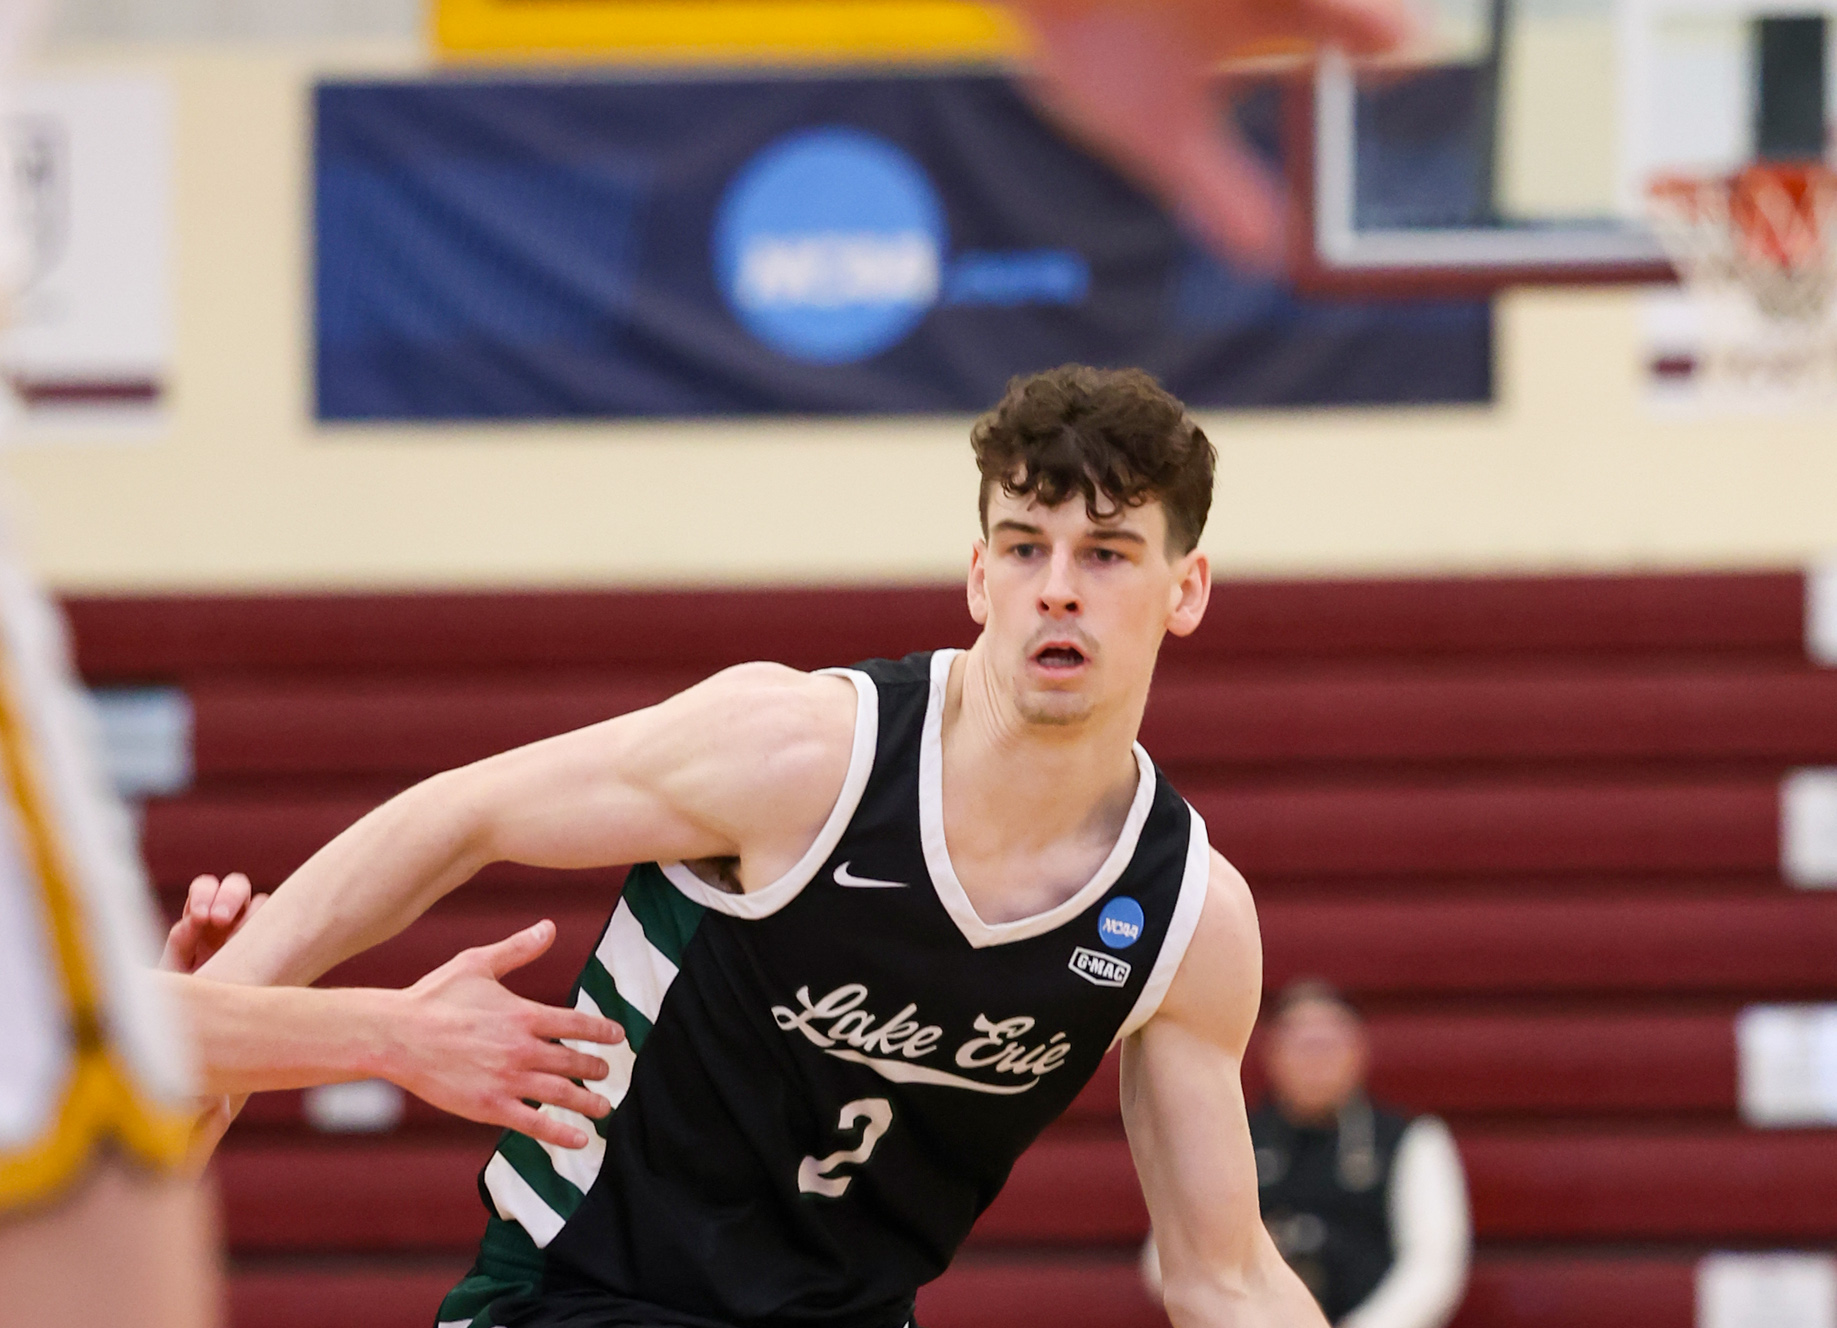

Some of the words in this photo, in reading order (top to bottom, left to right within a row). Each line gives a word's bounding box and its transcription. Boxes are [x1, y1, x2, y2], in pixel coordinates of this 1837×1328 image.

[1102, 917, 1139, 940] NCAA
[771, 983, 943, 1058] Lake
[955, 1012, 1071, 1075] Erie
[798, 1097, 893, 1198] 2
